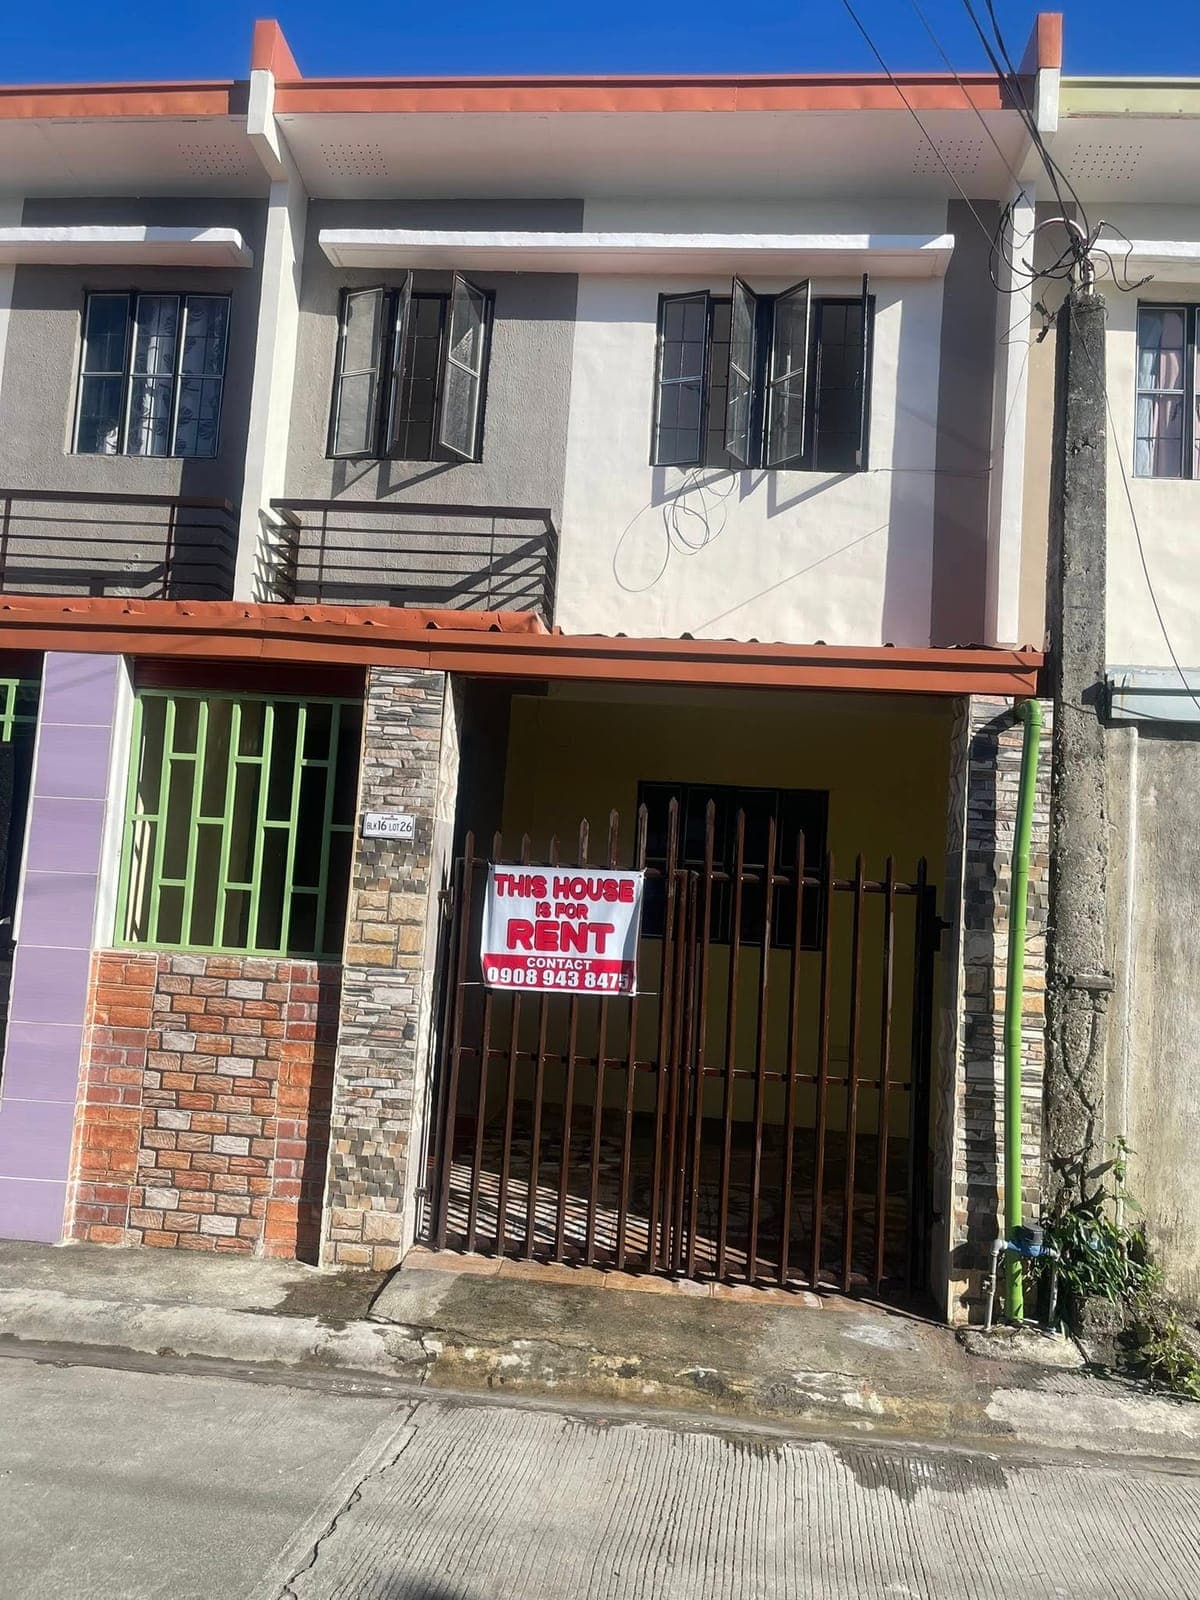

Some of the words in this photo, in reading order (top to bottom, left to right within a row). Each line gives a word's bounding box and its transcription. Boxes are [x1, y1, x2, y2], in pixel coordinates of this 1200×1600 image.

[400, 821, 412, 833] 26
[494, 873, 547, 898] THIS
[552, 876, 635, 903] HOUSE
[535, 901, 551, 918] IS
[555, 902, 589, 920] FOR
[506, 918, 615, 954] RENT
[526, 957, 592, 971] CONTACT
[487, 966, 537, 984] 0908
[543, 969, 579, 987] 943
[585, 972, 629, 990] 8475
